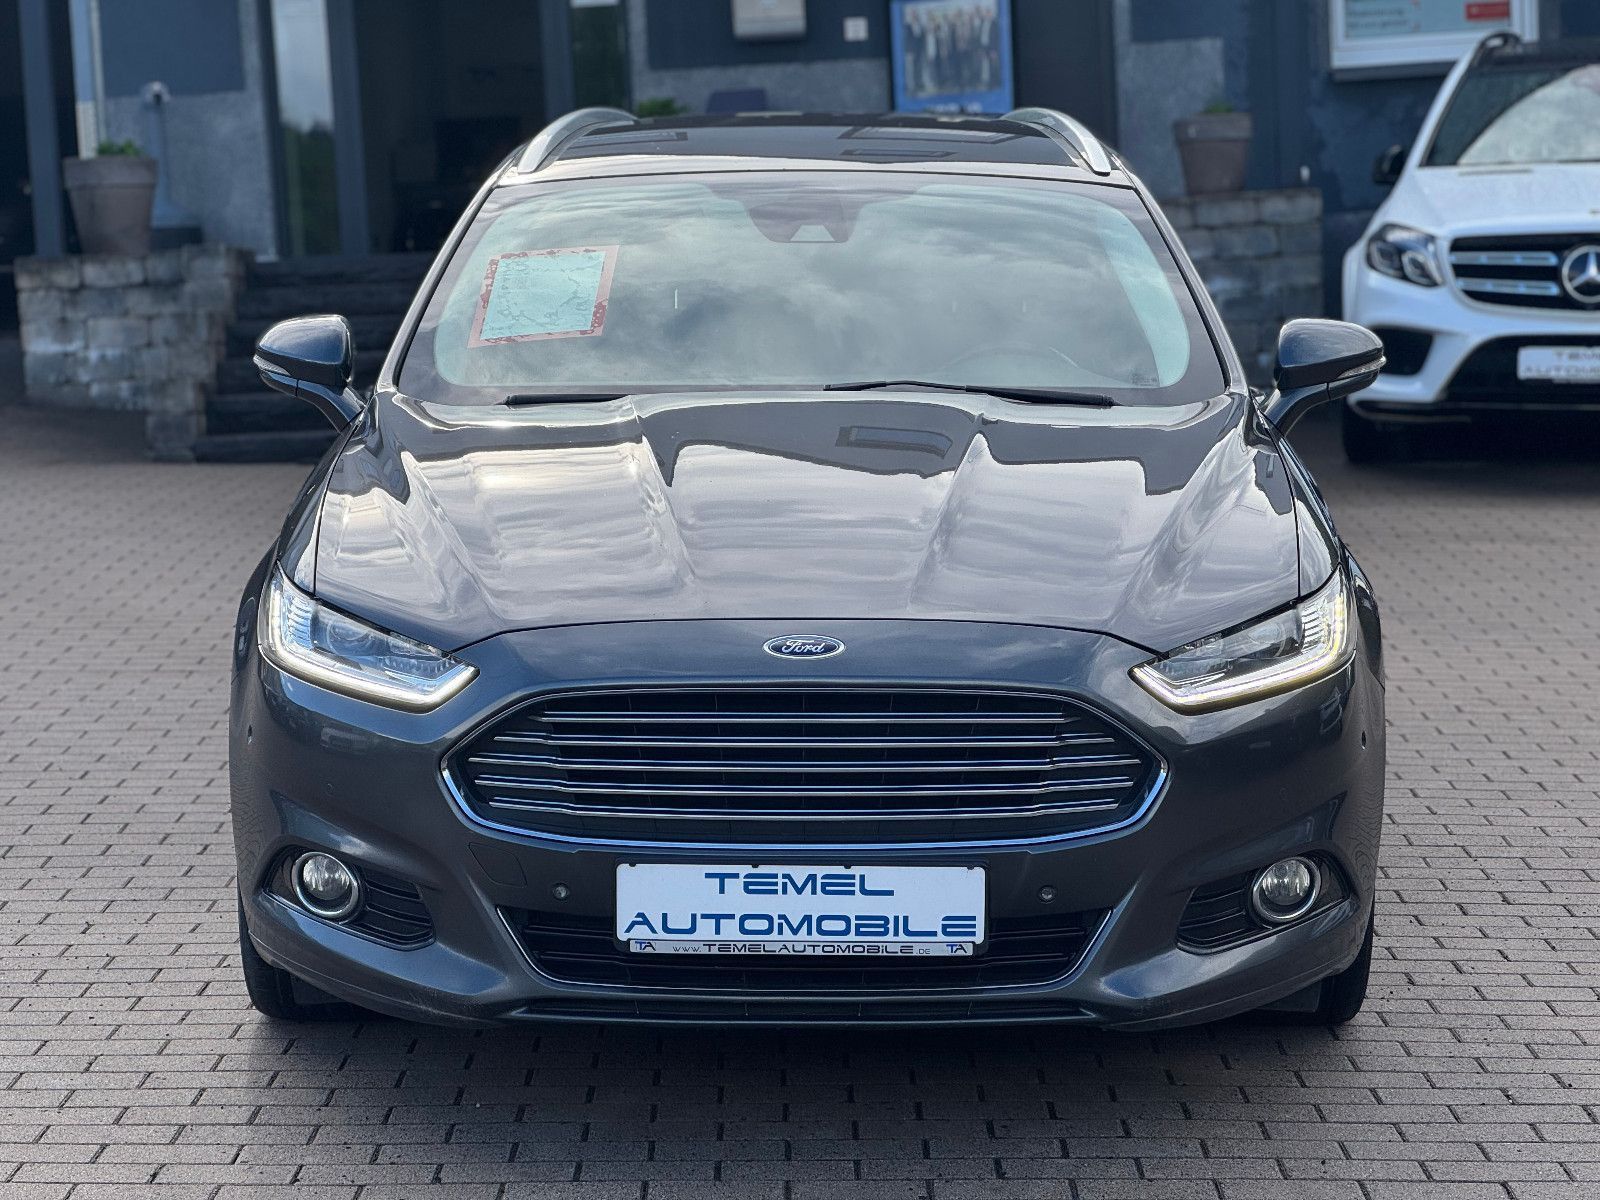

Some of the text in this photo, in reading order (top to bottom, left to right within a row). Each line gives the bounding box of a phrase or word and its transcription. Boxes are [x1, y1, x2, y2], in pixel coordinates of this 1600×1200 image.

[781, 639, 826, 653] Ford
[705, 873, 894, 896] TEMEL
[624, 912, 977, 937] AUTOMOBILE
[635, 941, 656, 951] TA
[946, 944, 968, 954] TA
